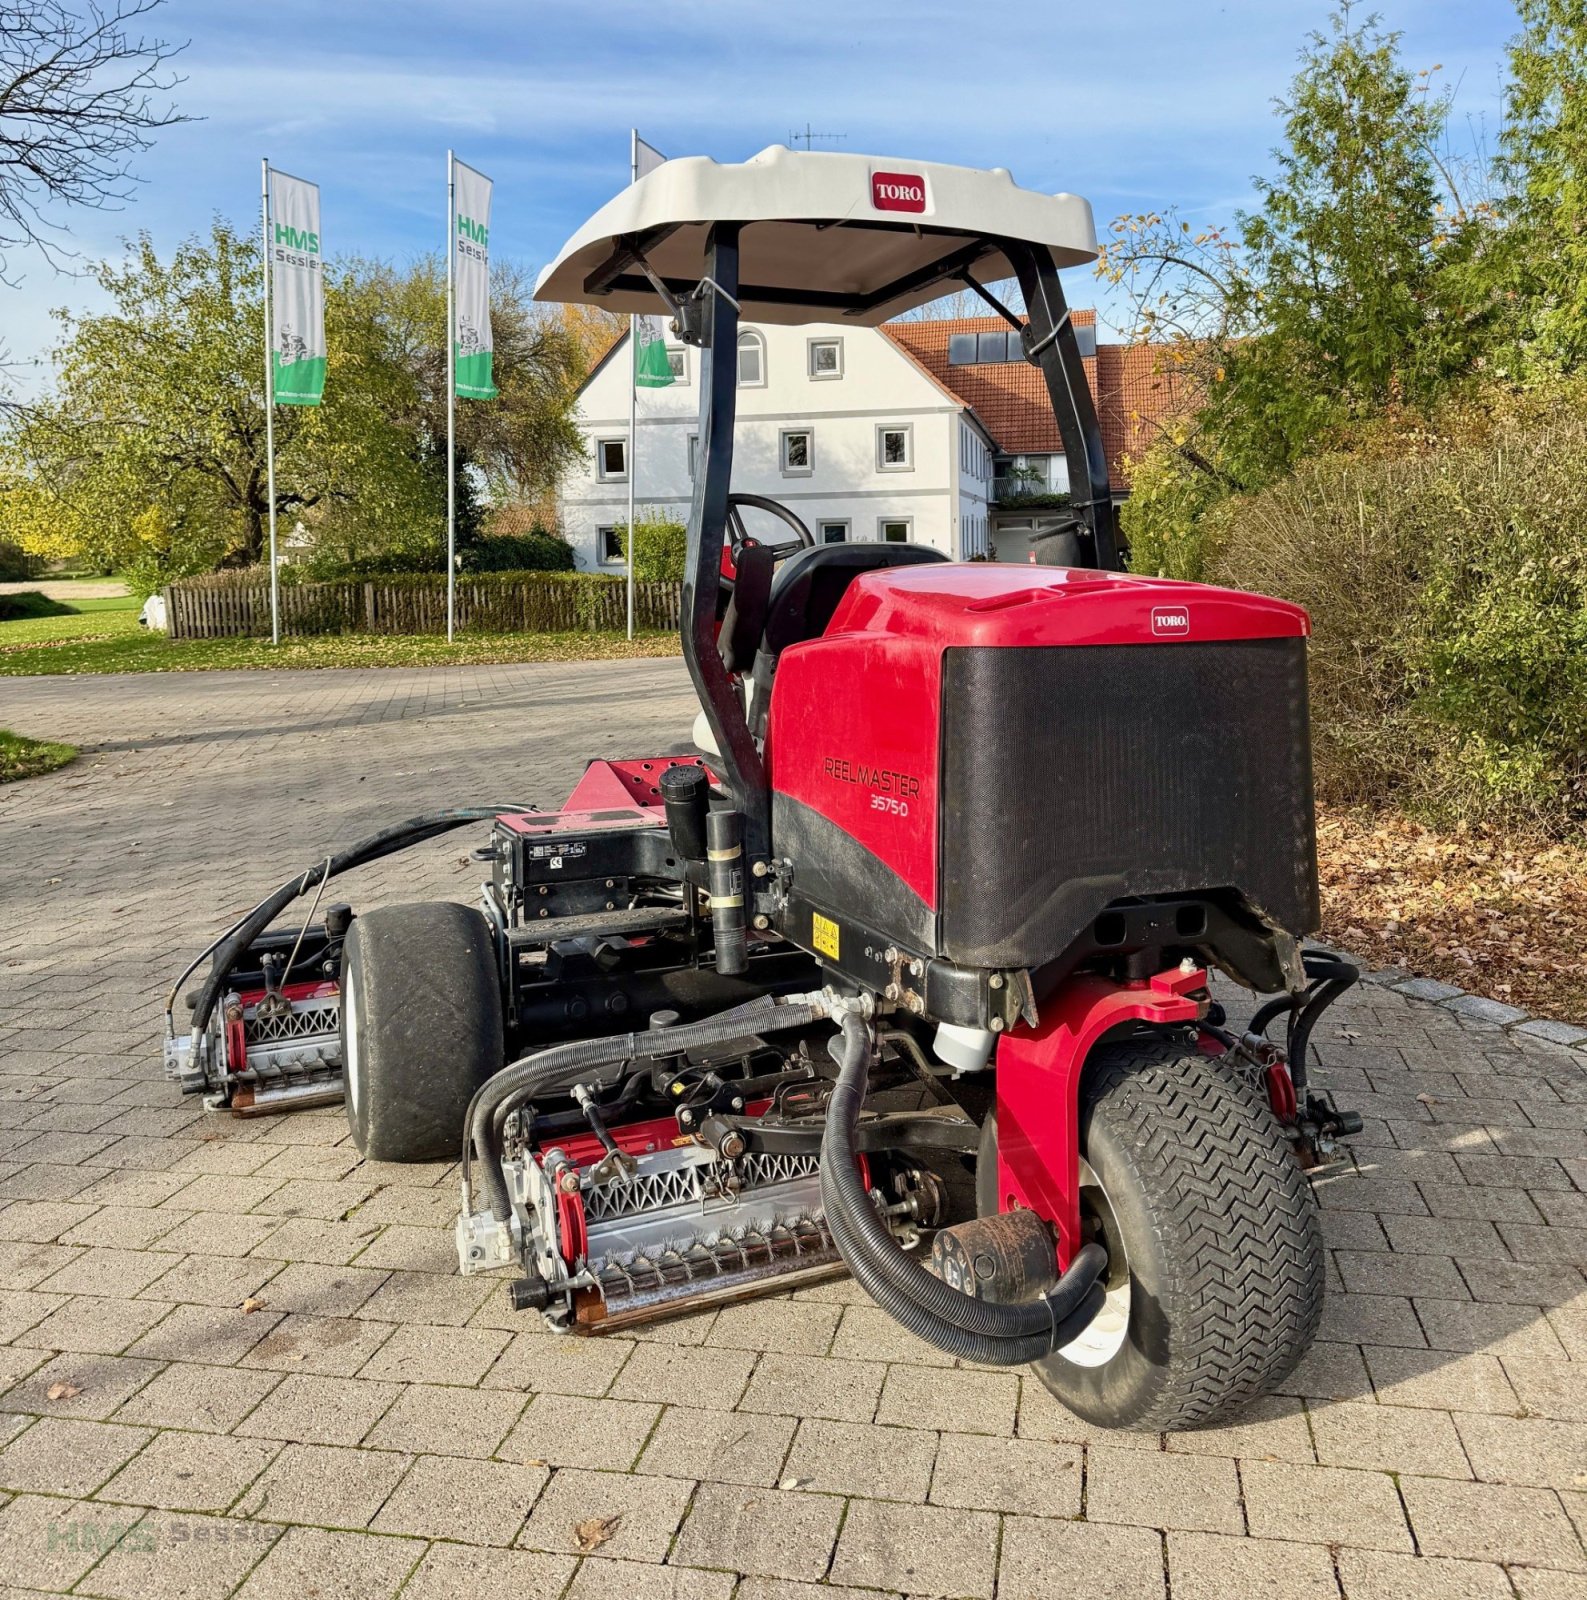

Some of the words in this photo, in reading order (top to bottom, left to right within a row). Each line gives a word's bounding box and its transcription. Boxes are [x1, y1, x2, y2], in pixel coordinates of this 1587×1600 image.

[876, 184, 923, 201] TORO
[275, 222, 319, 254] HMS
[1154, 615, 1187, 627] TORO
[825, 757, 920, 800] REELMASTER
